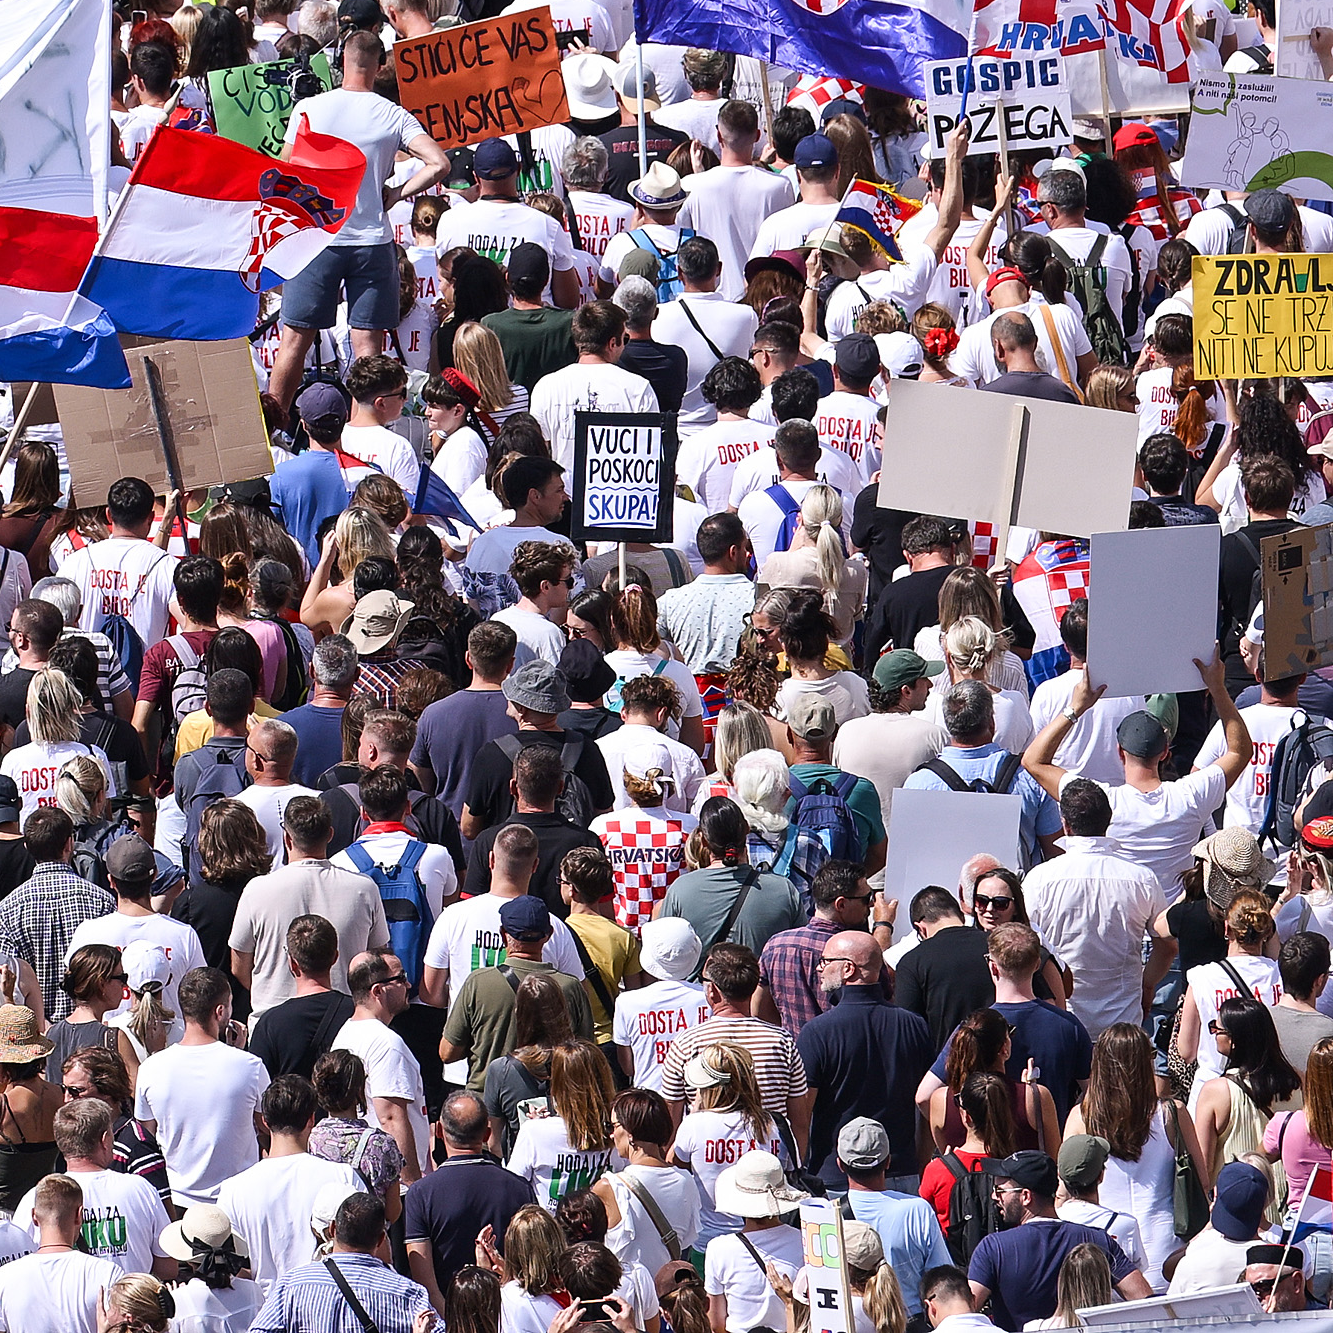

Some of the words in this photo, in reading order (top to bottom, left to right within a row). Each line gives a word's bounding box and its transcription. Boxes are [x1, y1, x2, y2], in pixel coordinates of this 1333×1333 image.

[495, 16, 549, 62] VAS
[1197, 88, 1204, 97] A
[1206, 88, 1219, 98] niti
[1240, 93, 1277, 104] potomci!
[1199, 78, 1225, 89] Nismo
[234, 84, 293, 118] VOD
[933, 103, 1071, 149] POŽEGA
[1211, 297, 1238, 336] SE
[1245, 297, 1274, 334] NE
[1198, 335, 1242, 377] NITI
[1243, 336, 1272, 375] NE
[589, 425, 641, 457] VUCI
[589, 456, 660, 485] POSKOCI
[589, 489, 659, 526] SKUPA!
[91, 569, 129, 594] DOSTA
[20, 766, 56, 793] DOST
[639, 1010, 688, 1036] DOSTA
